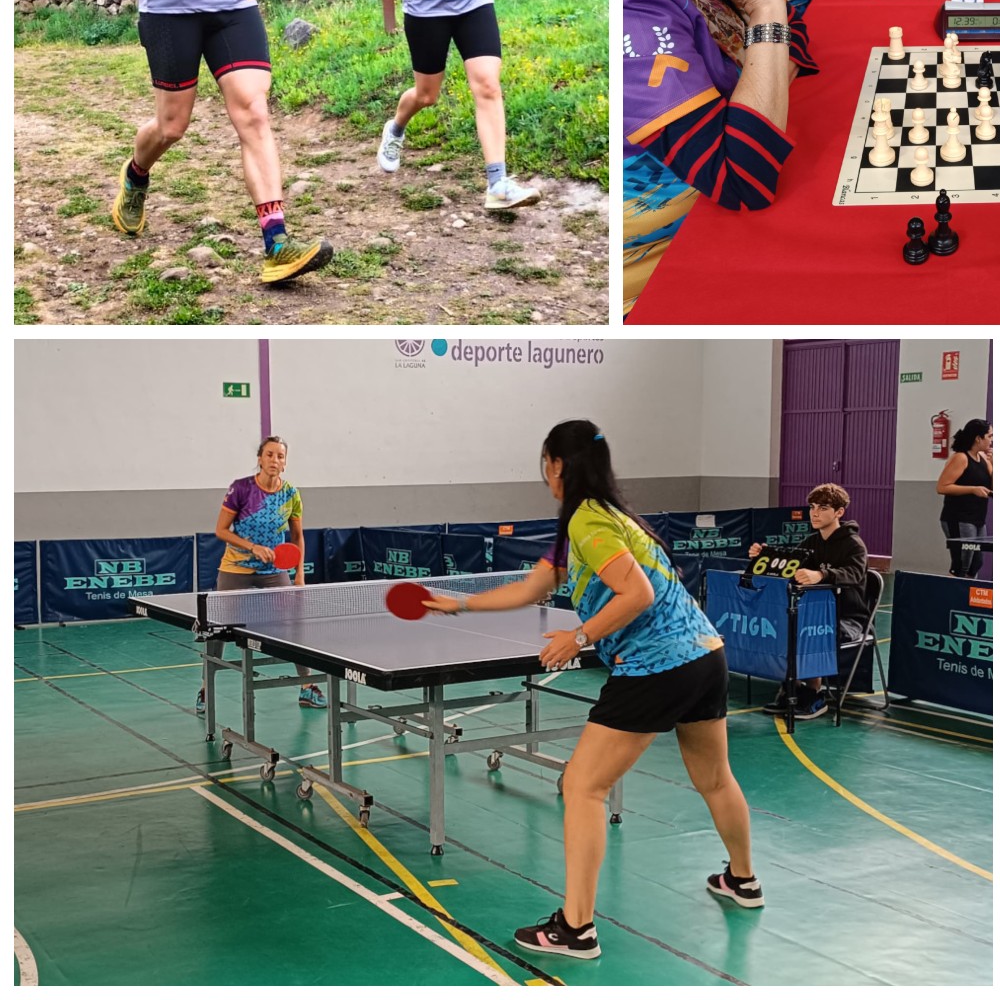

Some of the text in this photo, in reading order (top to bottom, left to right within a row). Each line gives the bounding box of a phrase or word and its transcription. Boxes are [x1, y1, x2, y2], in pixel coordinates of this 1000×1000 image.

[451, 339, 605, 369] deporte lagunero
[902, 373, 921, 382] SALIDA
[692, 528, 720, 539] NB
[784, 522, 810, 534] NB
[672, 537, 742, 551] ENEBE
[961, 543, 981, 551] JOOLA
[387, 551, 410, 565] NB
[98, 560, 143, 574] NB
[373, 561, 431, 579] ENEBE
[752, 556, 770, 575] 6
[781, 559, 800, 578] 8
[64, 572, 177, 590] ENEBE
[85, 590, 154, 600] Tenis de Mesa
[135, 605, 148, 617] JOOLA
[715, 611, 777, 639] STIGA
[799, 624, 834, 637] STIGA
[936, 657, 969, 675] Tenis
[970, 665, 985, 678] de
[344, 667, 367, 685] JOOLA
